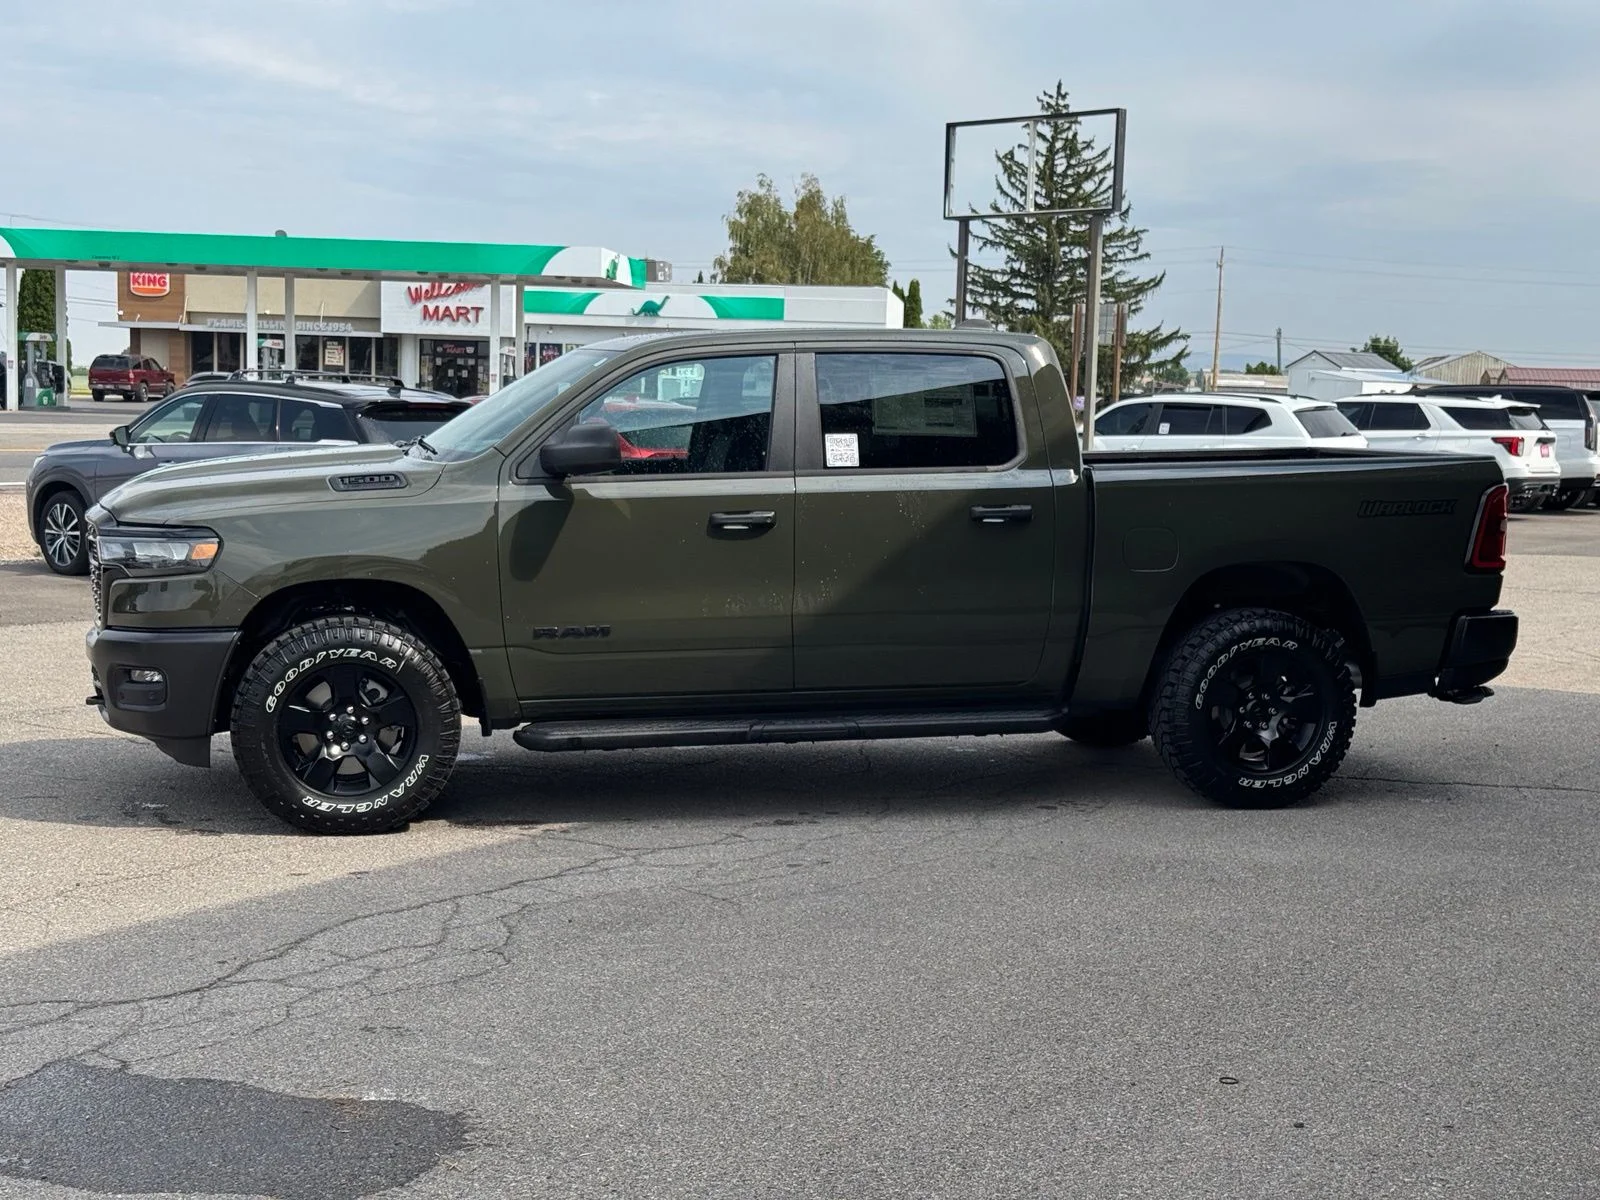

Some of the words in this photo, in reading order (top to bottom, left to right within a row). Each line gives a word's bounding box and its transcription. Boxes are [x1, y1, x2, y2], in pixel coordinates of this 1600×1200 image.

[132, 274, 167, 287] KING
[422, 305, 484, 323] MART
[295, 320, 327, 331] SINCE
[327, 322, 353, 332] 1954
[337, 474, 396, 486] 1500
[1357, 499, 1459, 518] WARLOCK
[533, 625, 612, 640] RAM
[265, 648, 398, 713] GOODYEAR
[1195, 637, 1298, 709] GOODYEAR
[1239, 721, 1337, 789] WRANGLER
[302, 754, 430, 814] WRANGLER
